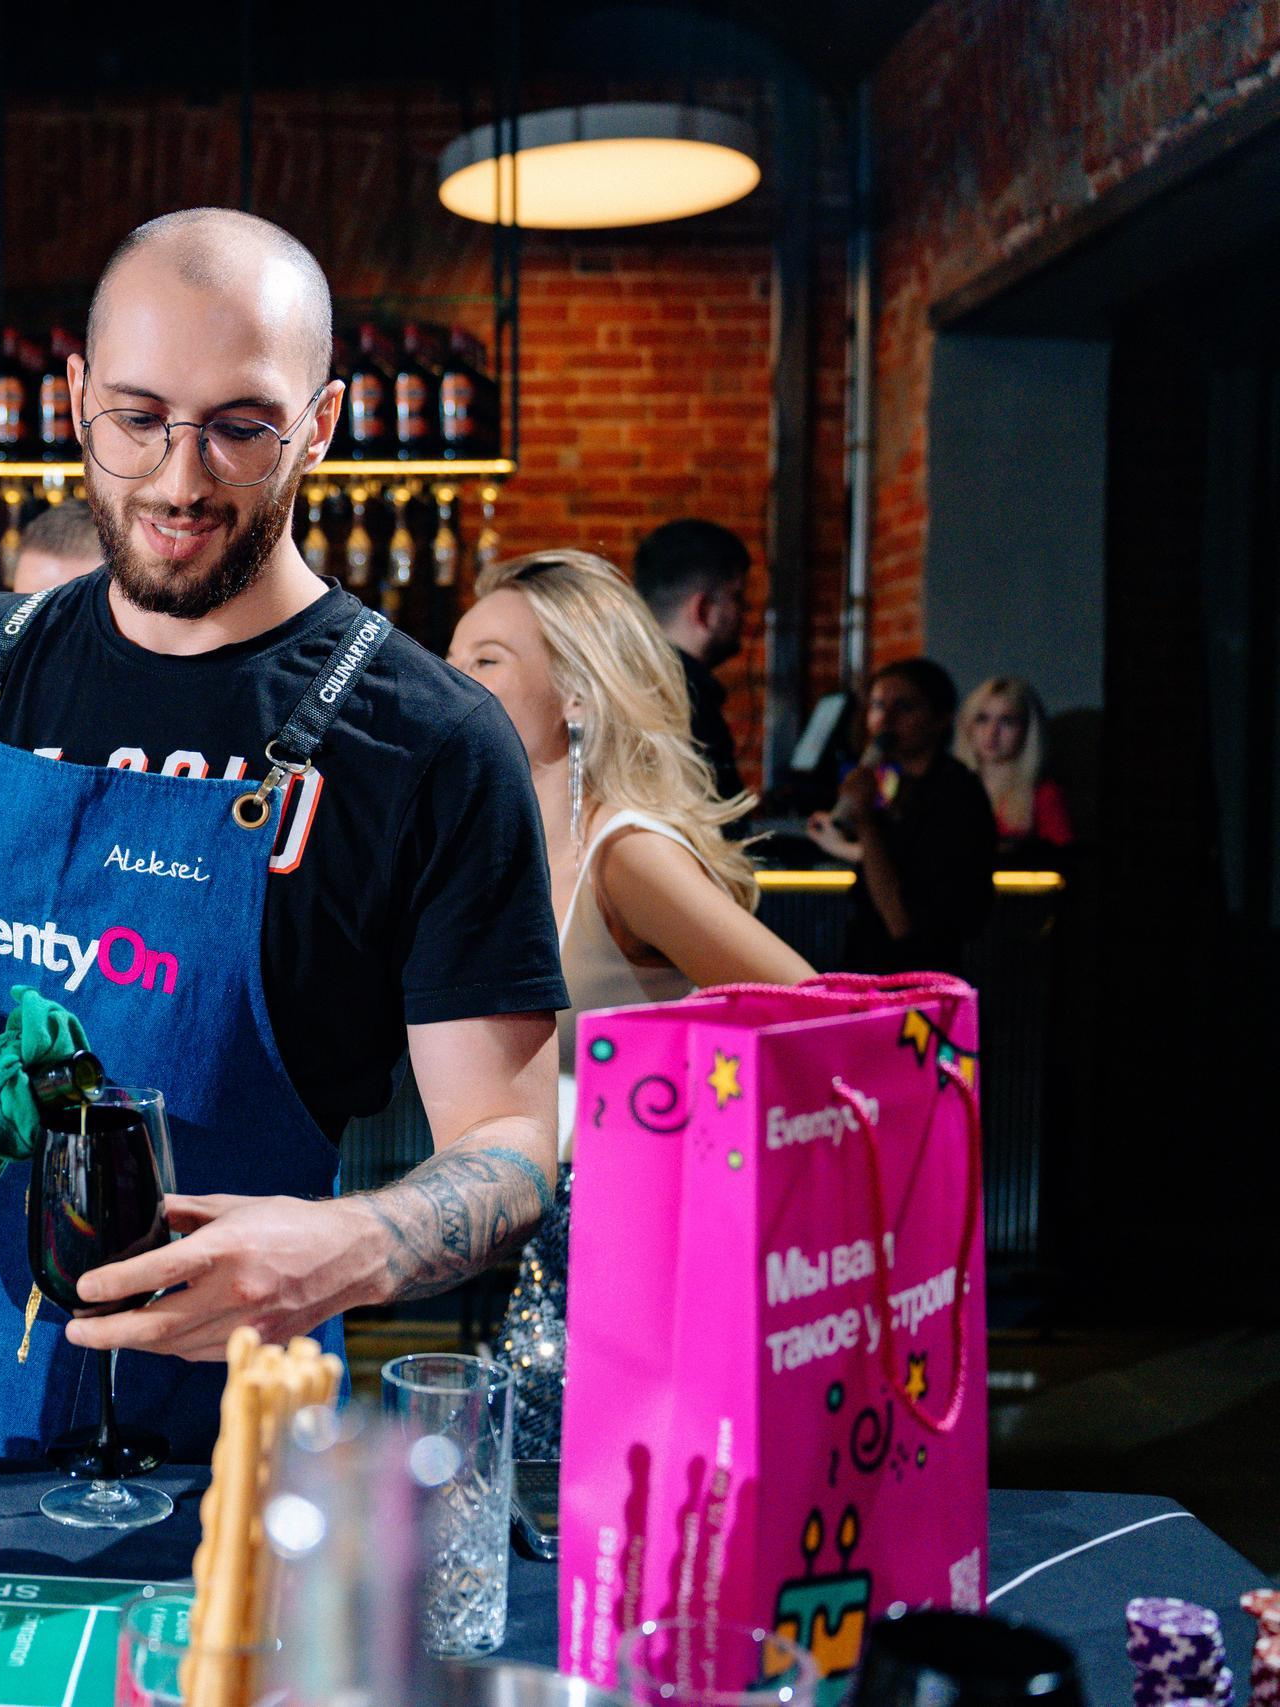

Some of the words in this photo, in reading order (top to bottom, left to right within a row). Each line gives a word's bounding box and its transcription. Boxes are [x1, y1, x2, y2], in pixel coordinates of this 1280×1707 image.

[320, 620, 381, 703] CULINARYON
[104, 845, 210, 881] Aleksei
[766, 1246, 828, 1307] Мы
[765, 1308, 861, 1375] такое
[8, 1615, 41, 1666] cinnamon
